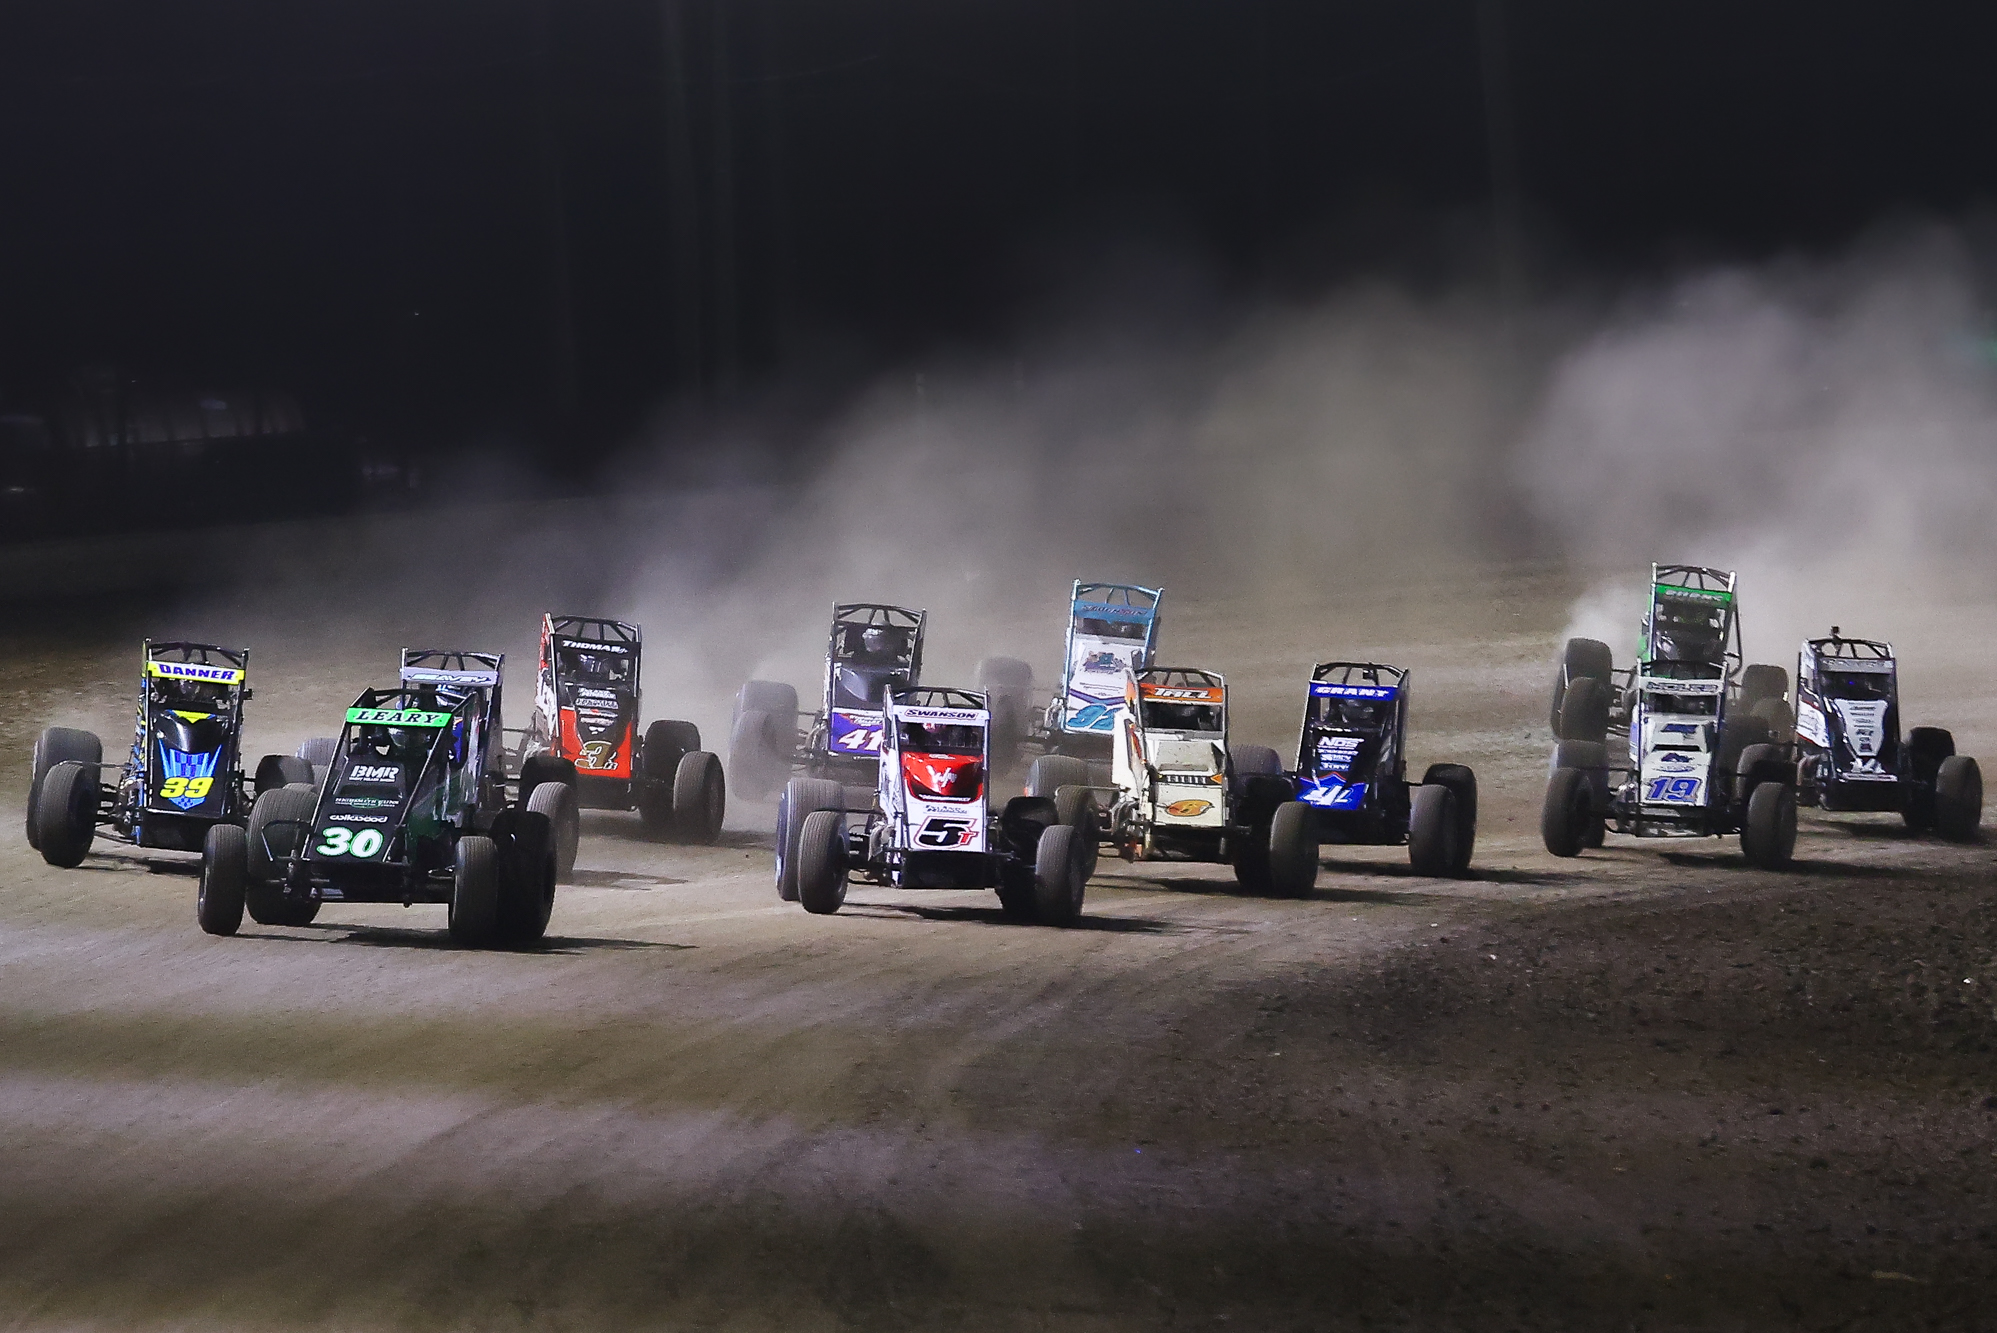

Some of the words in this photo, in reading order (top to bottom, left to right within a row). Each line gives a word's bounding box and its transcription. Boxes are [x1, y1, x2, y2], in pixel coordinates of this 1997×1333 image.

[158, 664, 235, 680] DANNER
[1315, 687, 1389, 697] GRANT
[356, 710, 440, 724] LEARY
[906, 709, 977, 719] SWANSON
[838, 729, 883, 750] 41
[1318, 736, 1364, 748] NOS
[350, 765, 399, 779] BMR
[160, 777, 214, 798] 39
[1646, 776, 1702, 802] 19
[316, 826, 384, 858] 30
